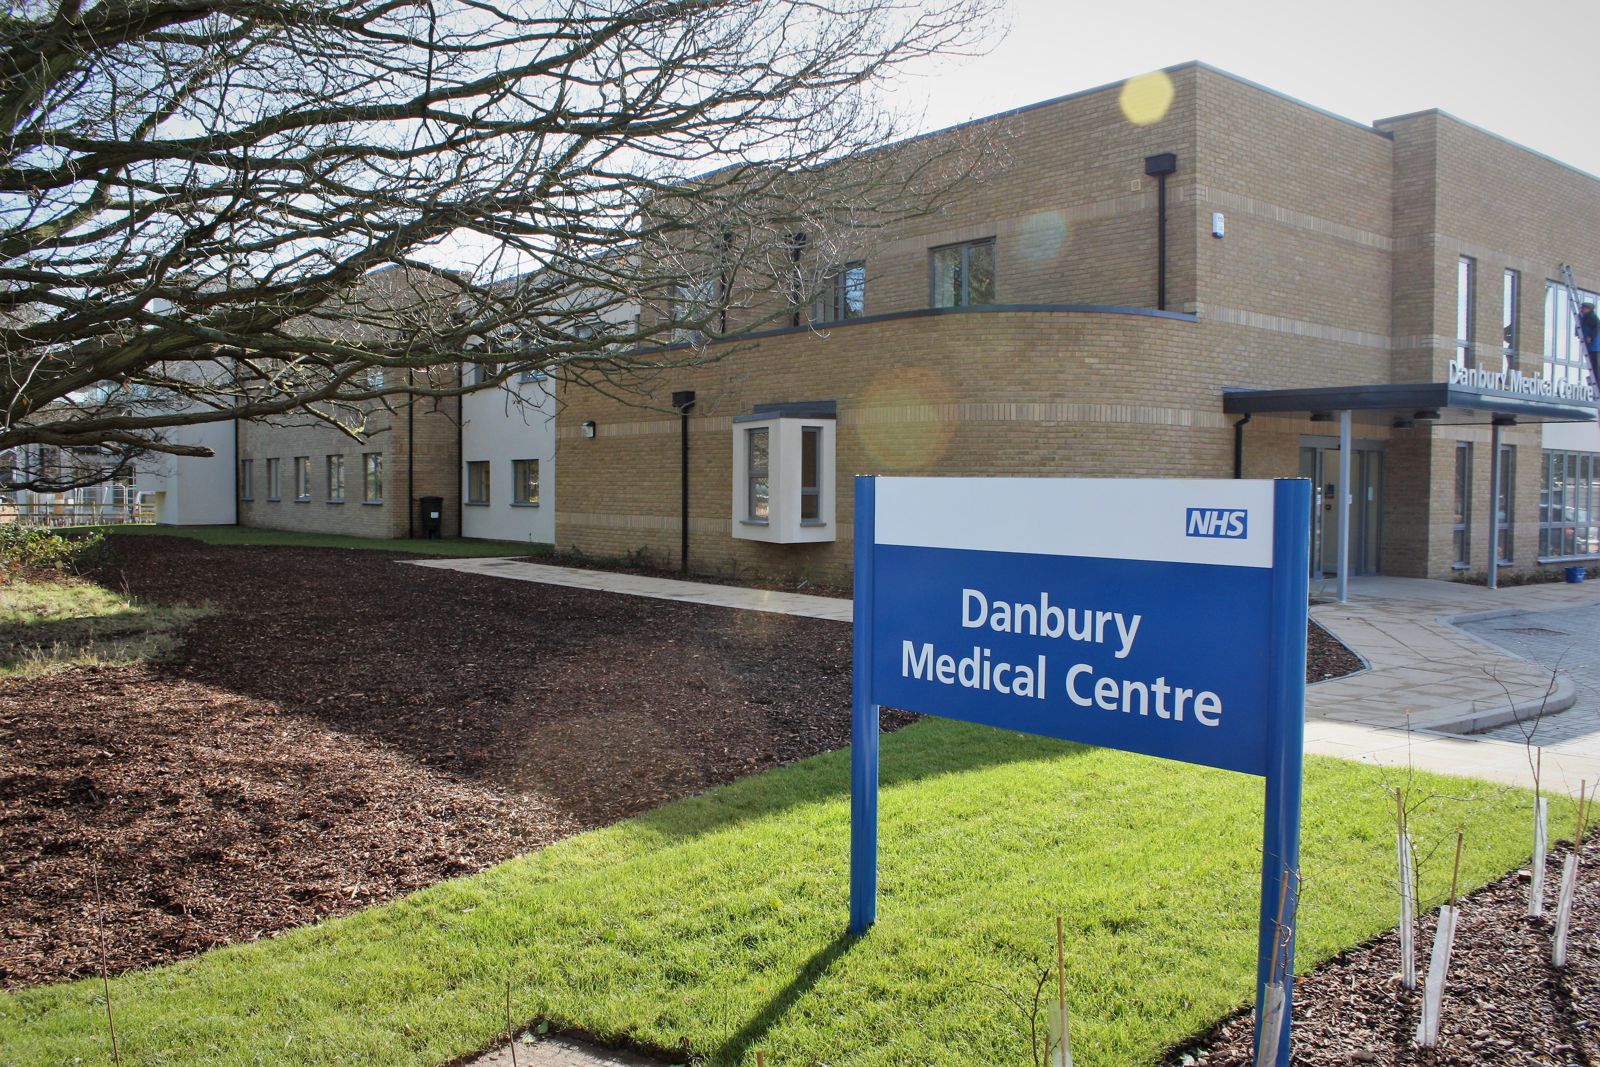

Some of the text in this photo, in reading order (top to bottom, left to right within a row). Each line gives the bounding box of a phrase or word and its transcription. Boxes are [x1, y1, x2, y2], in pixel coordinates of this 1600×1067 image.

[1449, 359, 1593, 401] Danbury Medical Centre
[1187, 509, 1245, 537] NHS
[962, 588, 1142, 658] Danbury
[902, 640, 1222, 727] Medical Centre
